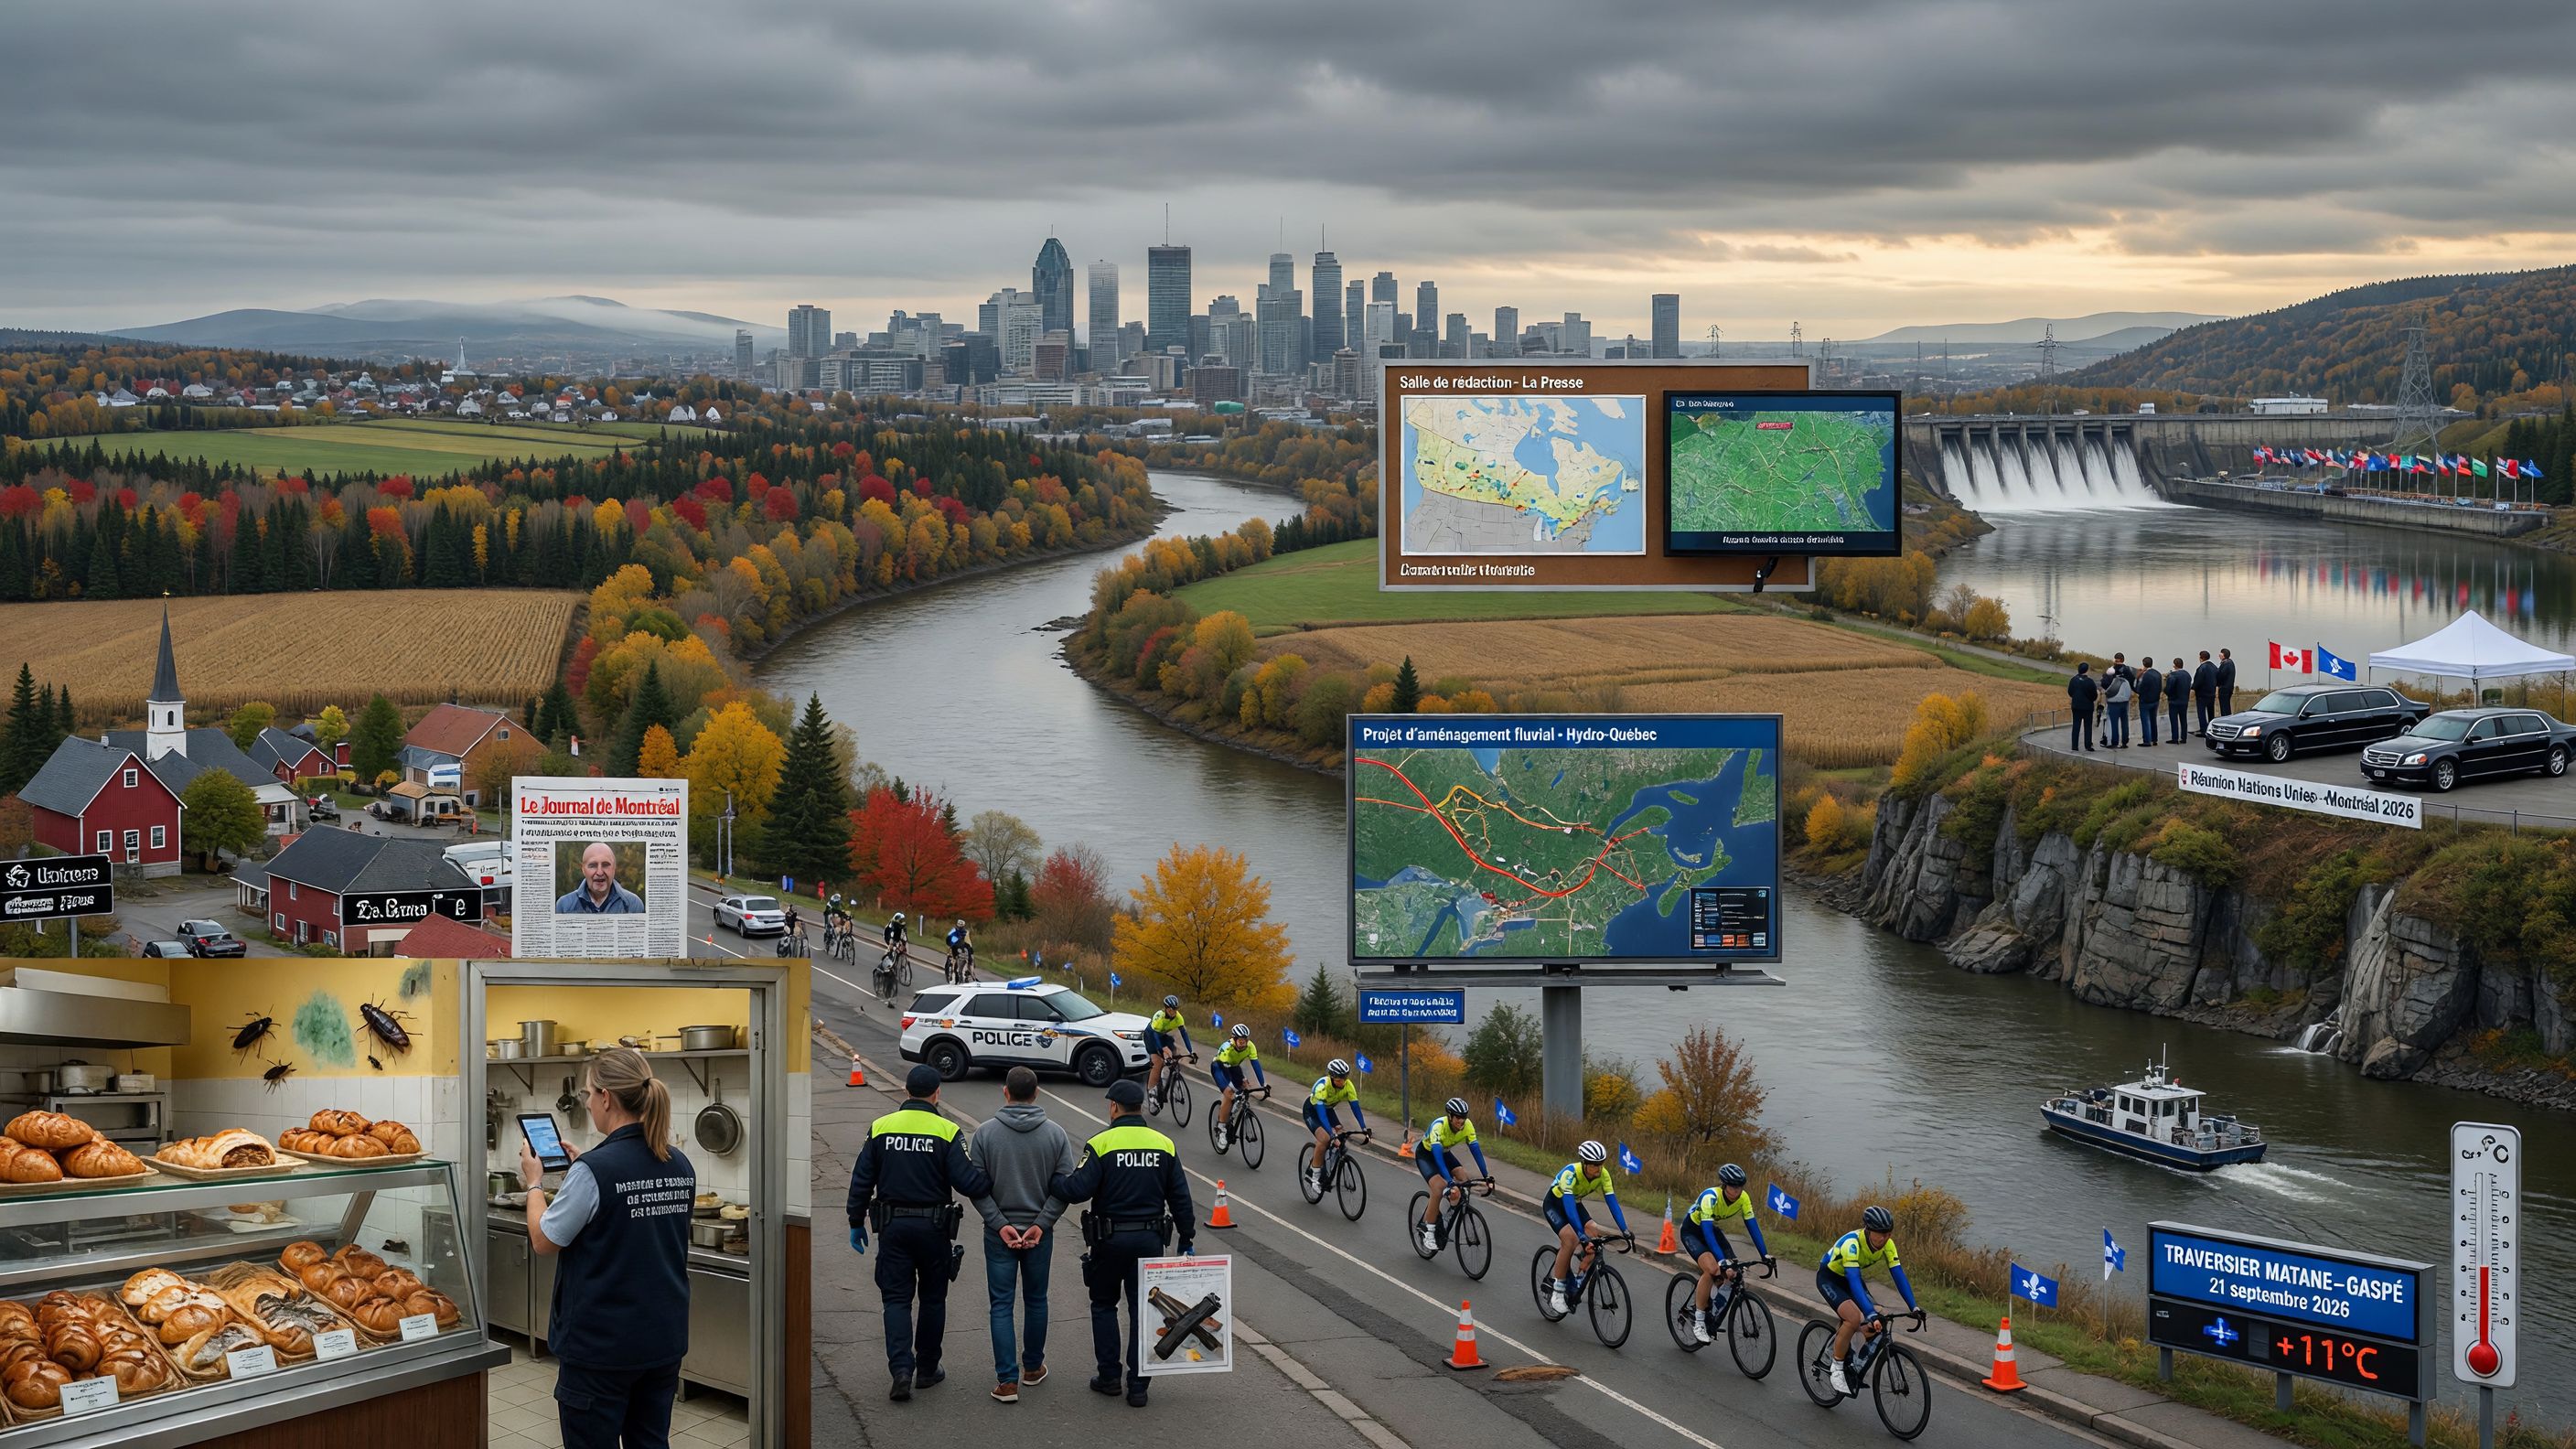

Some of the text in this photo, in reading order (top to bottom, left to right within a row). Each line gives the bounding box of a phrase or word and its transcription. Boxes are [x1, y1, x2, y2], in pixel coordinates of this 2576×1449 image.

[1400, 374, 1431, 389] Salle
[1433, 375, 1449, 389] de
[1522, 375, 1538, 389] La
[1540, 375, 1583, 389] Presse
[1363, 727, 1402, 744] Projet
[1514, 726, 1555, 742] fluvial
[1566, 727, 1658, 745] Hydro-Québec
[521, 797, 538, 814] Le
[541, 796, 594, 815] Journal
[596, 797, 613, 815] de
[2191, 770, 2235, 791] Réunion
[2382, 799, 2414, 819] 2026
[1116, 1152, 1160, 1167] POLICE
[2163, 1243, 2260, 1278] TRAVERSIER
[2209, 1277, 2350, 1318] 21 septembre 2026
[2276, 1335, 2378, 1379] +11°C
